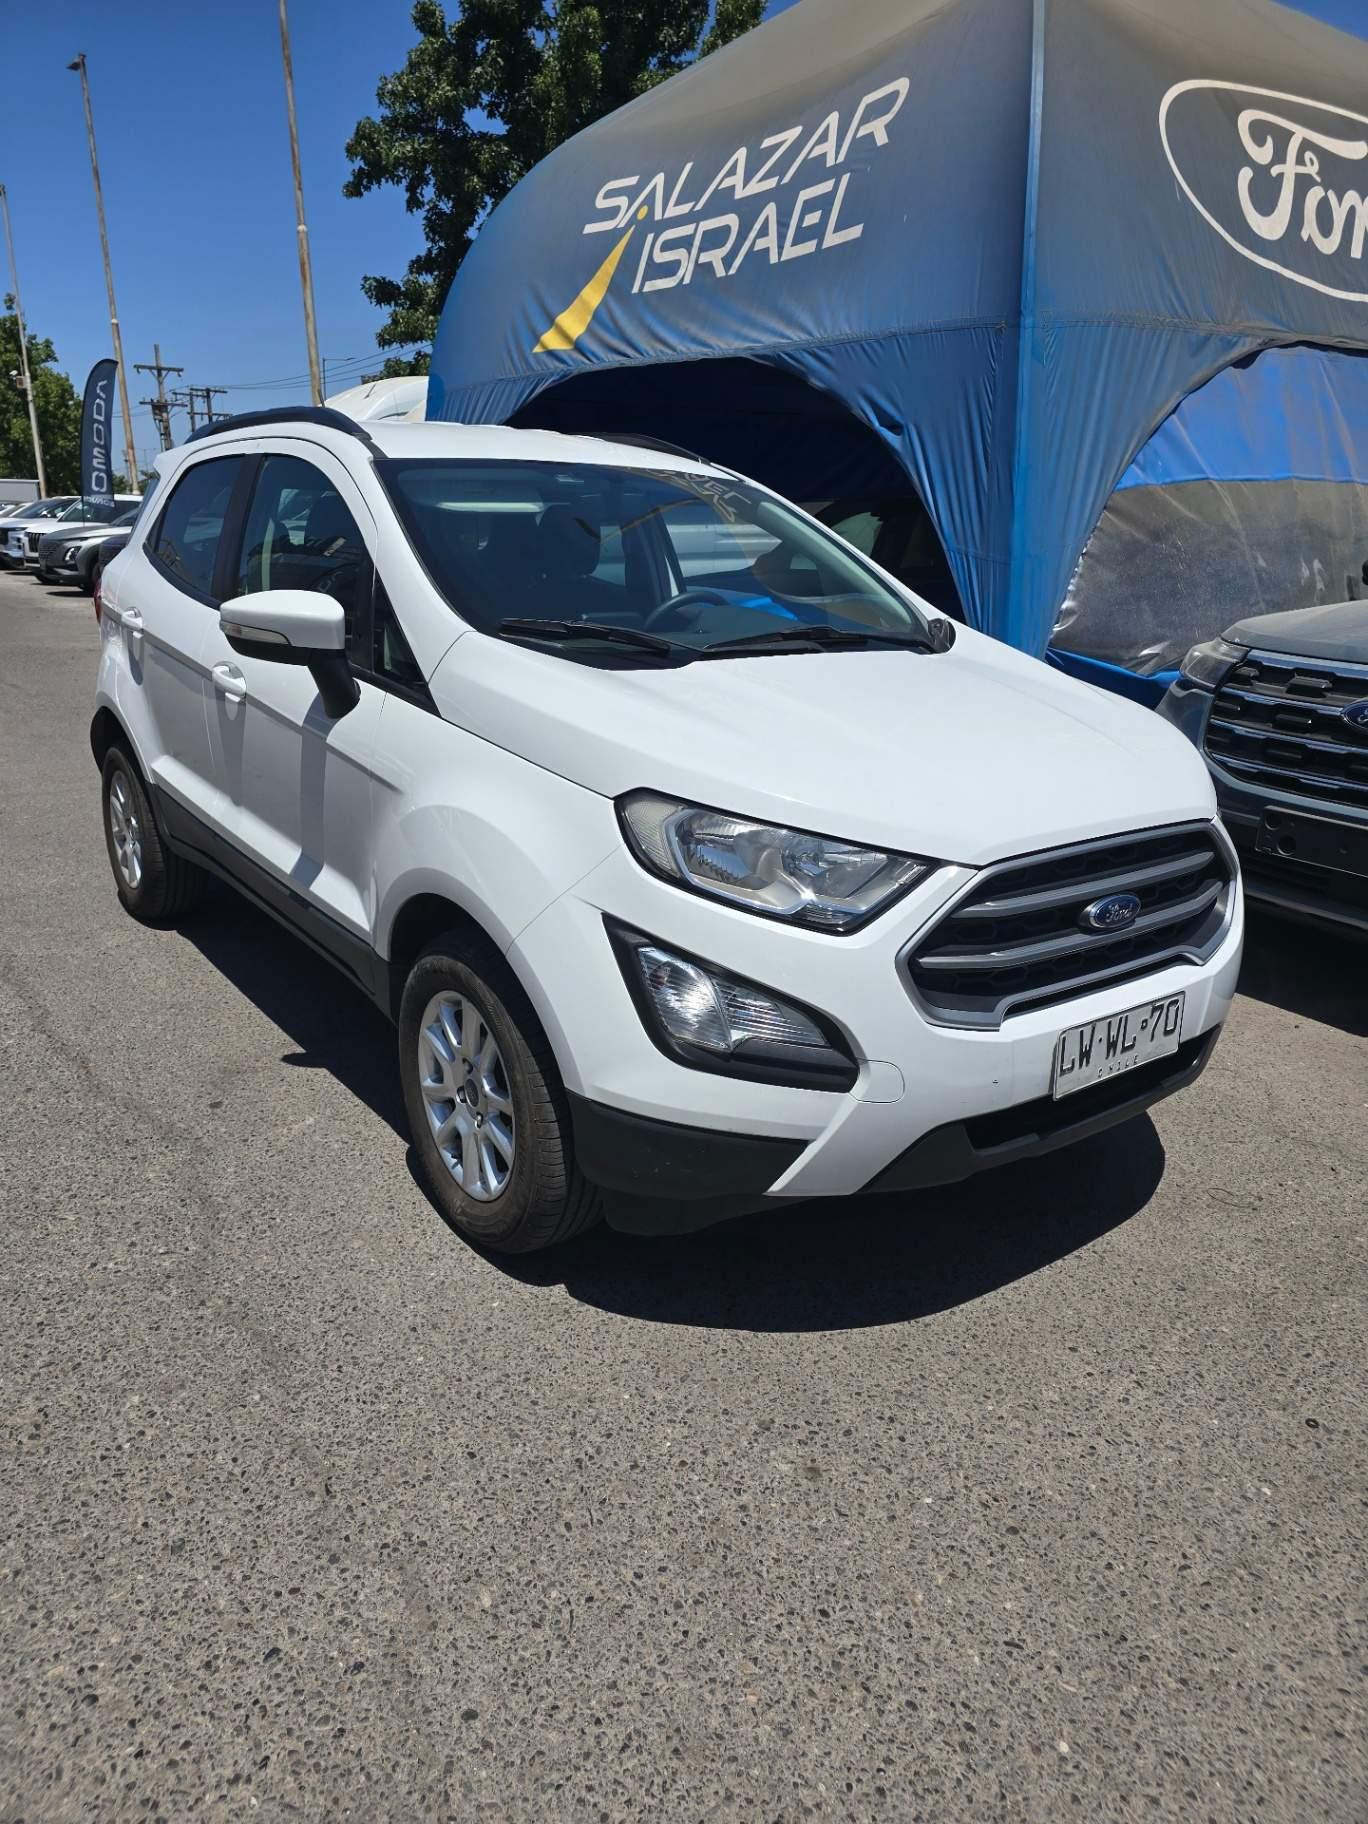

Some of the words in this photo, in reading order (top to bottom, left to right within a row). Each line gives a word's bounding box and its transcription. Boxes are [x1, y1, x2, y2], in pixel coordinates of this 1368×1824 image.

[582, 76, 910, 235] SALAZAR
[1237, 108, 1368, 260] For
[631, 172, 865, 294] ISRAEL
[91, 380, 108, 493] OMODA
